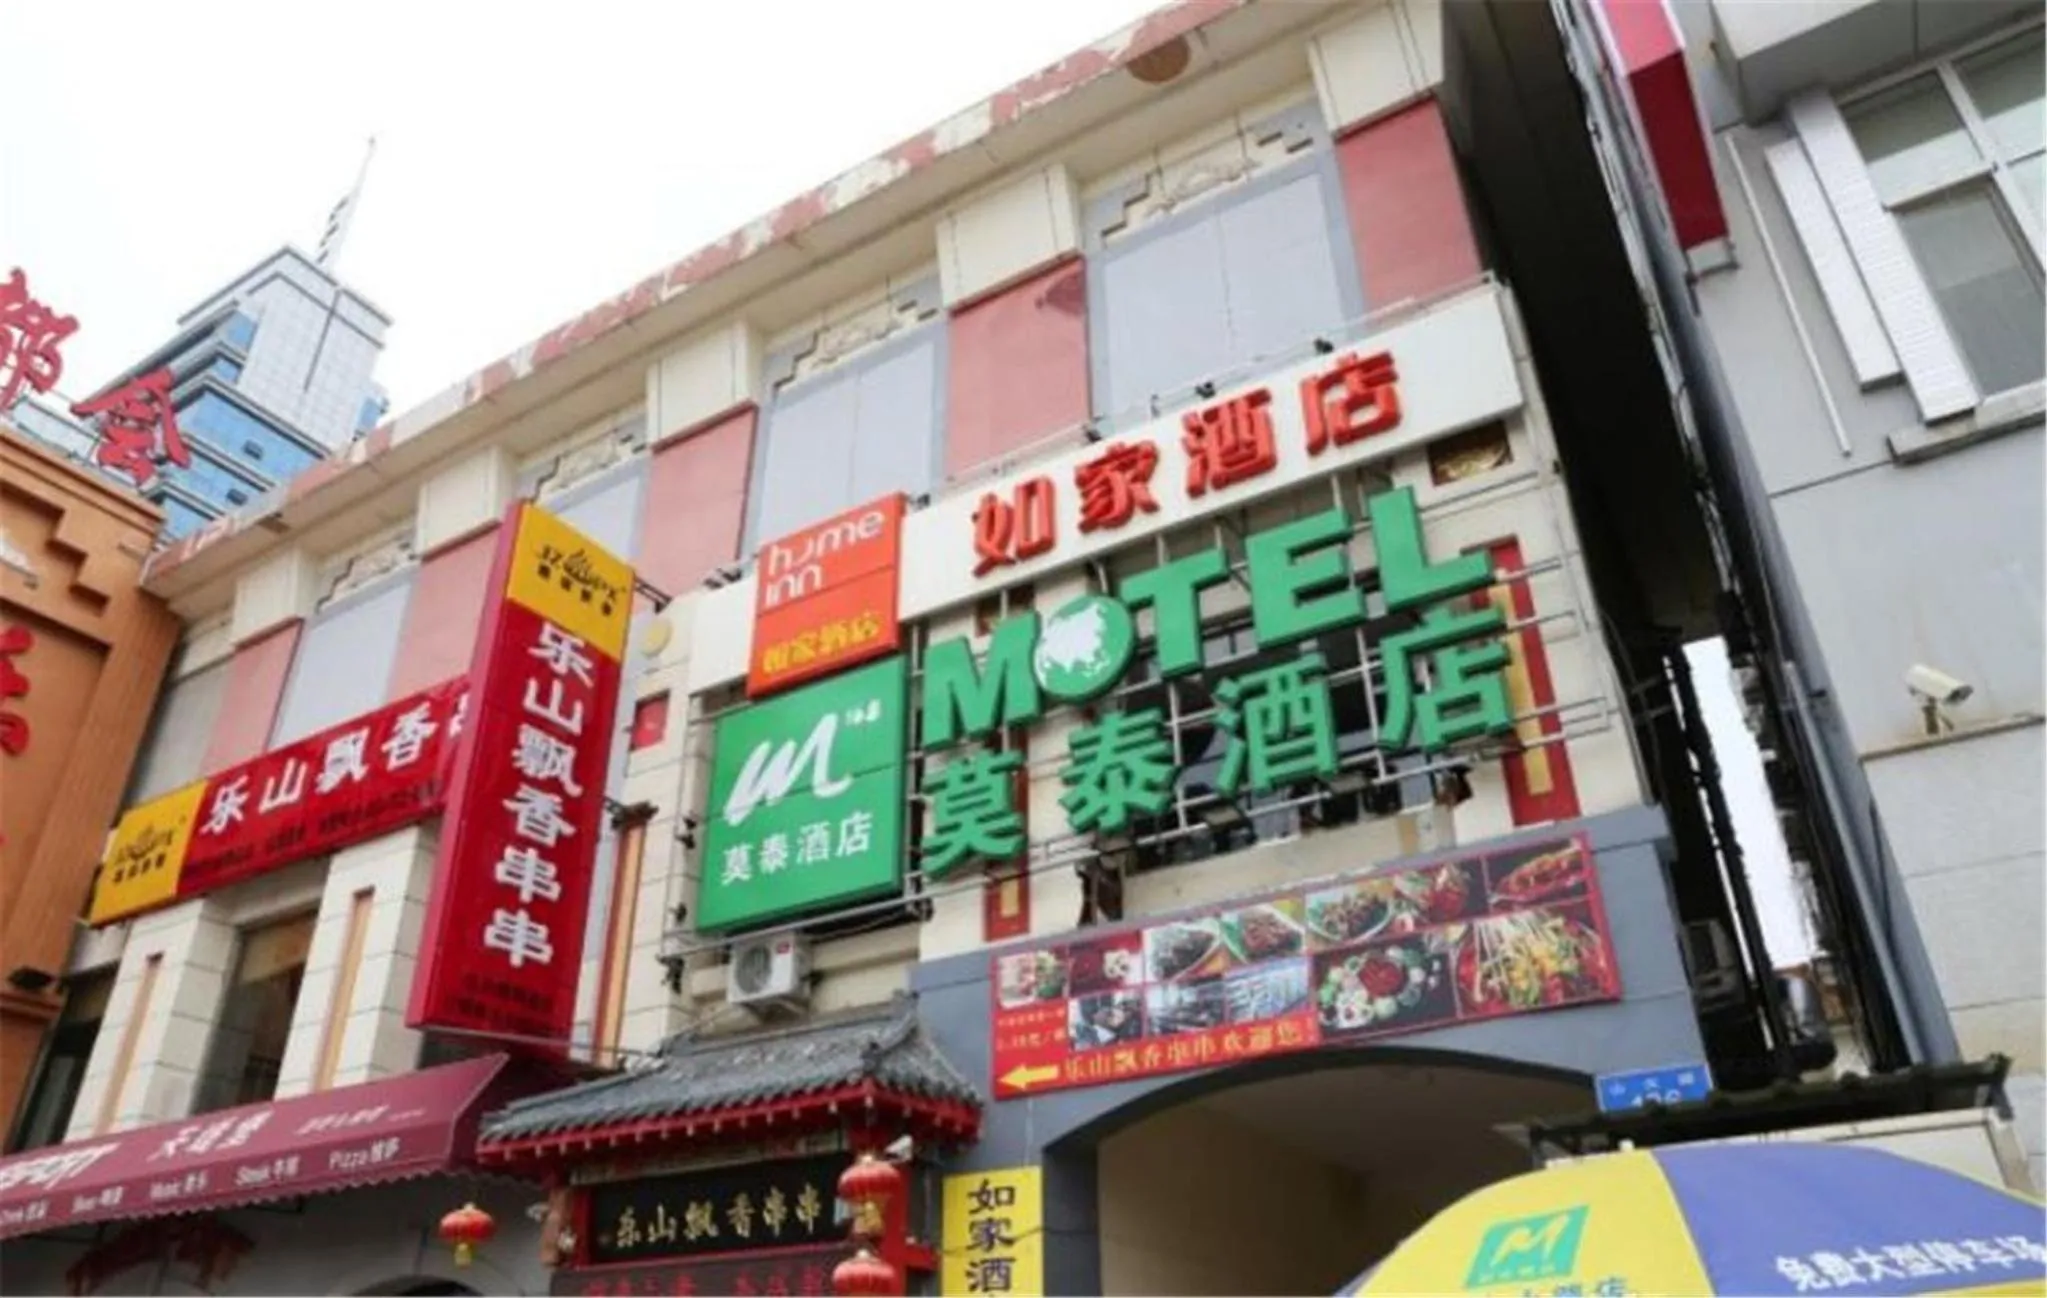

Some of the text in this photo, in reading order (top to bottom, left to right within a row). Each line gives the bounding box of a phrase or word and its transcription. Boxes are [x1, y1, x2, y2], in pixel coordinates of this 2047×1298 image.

[971, 350, 1402, 578] 如家酒店
[921, 484, 1496, 753] MOTEL
[484, 620, 596, 969] 乐山飘香串串
[919, 603, 1513, 883] 莫泰酒店
[721, 809, 876, 887] 莫泰酒店
[328, 1148, 368, 1172] Pizza
[616, 1181, 821, 1248] 乐山飘香串串
[964, 1178, 1017, 1298] 如家酒
